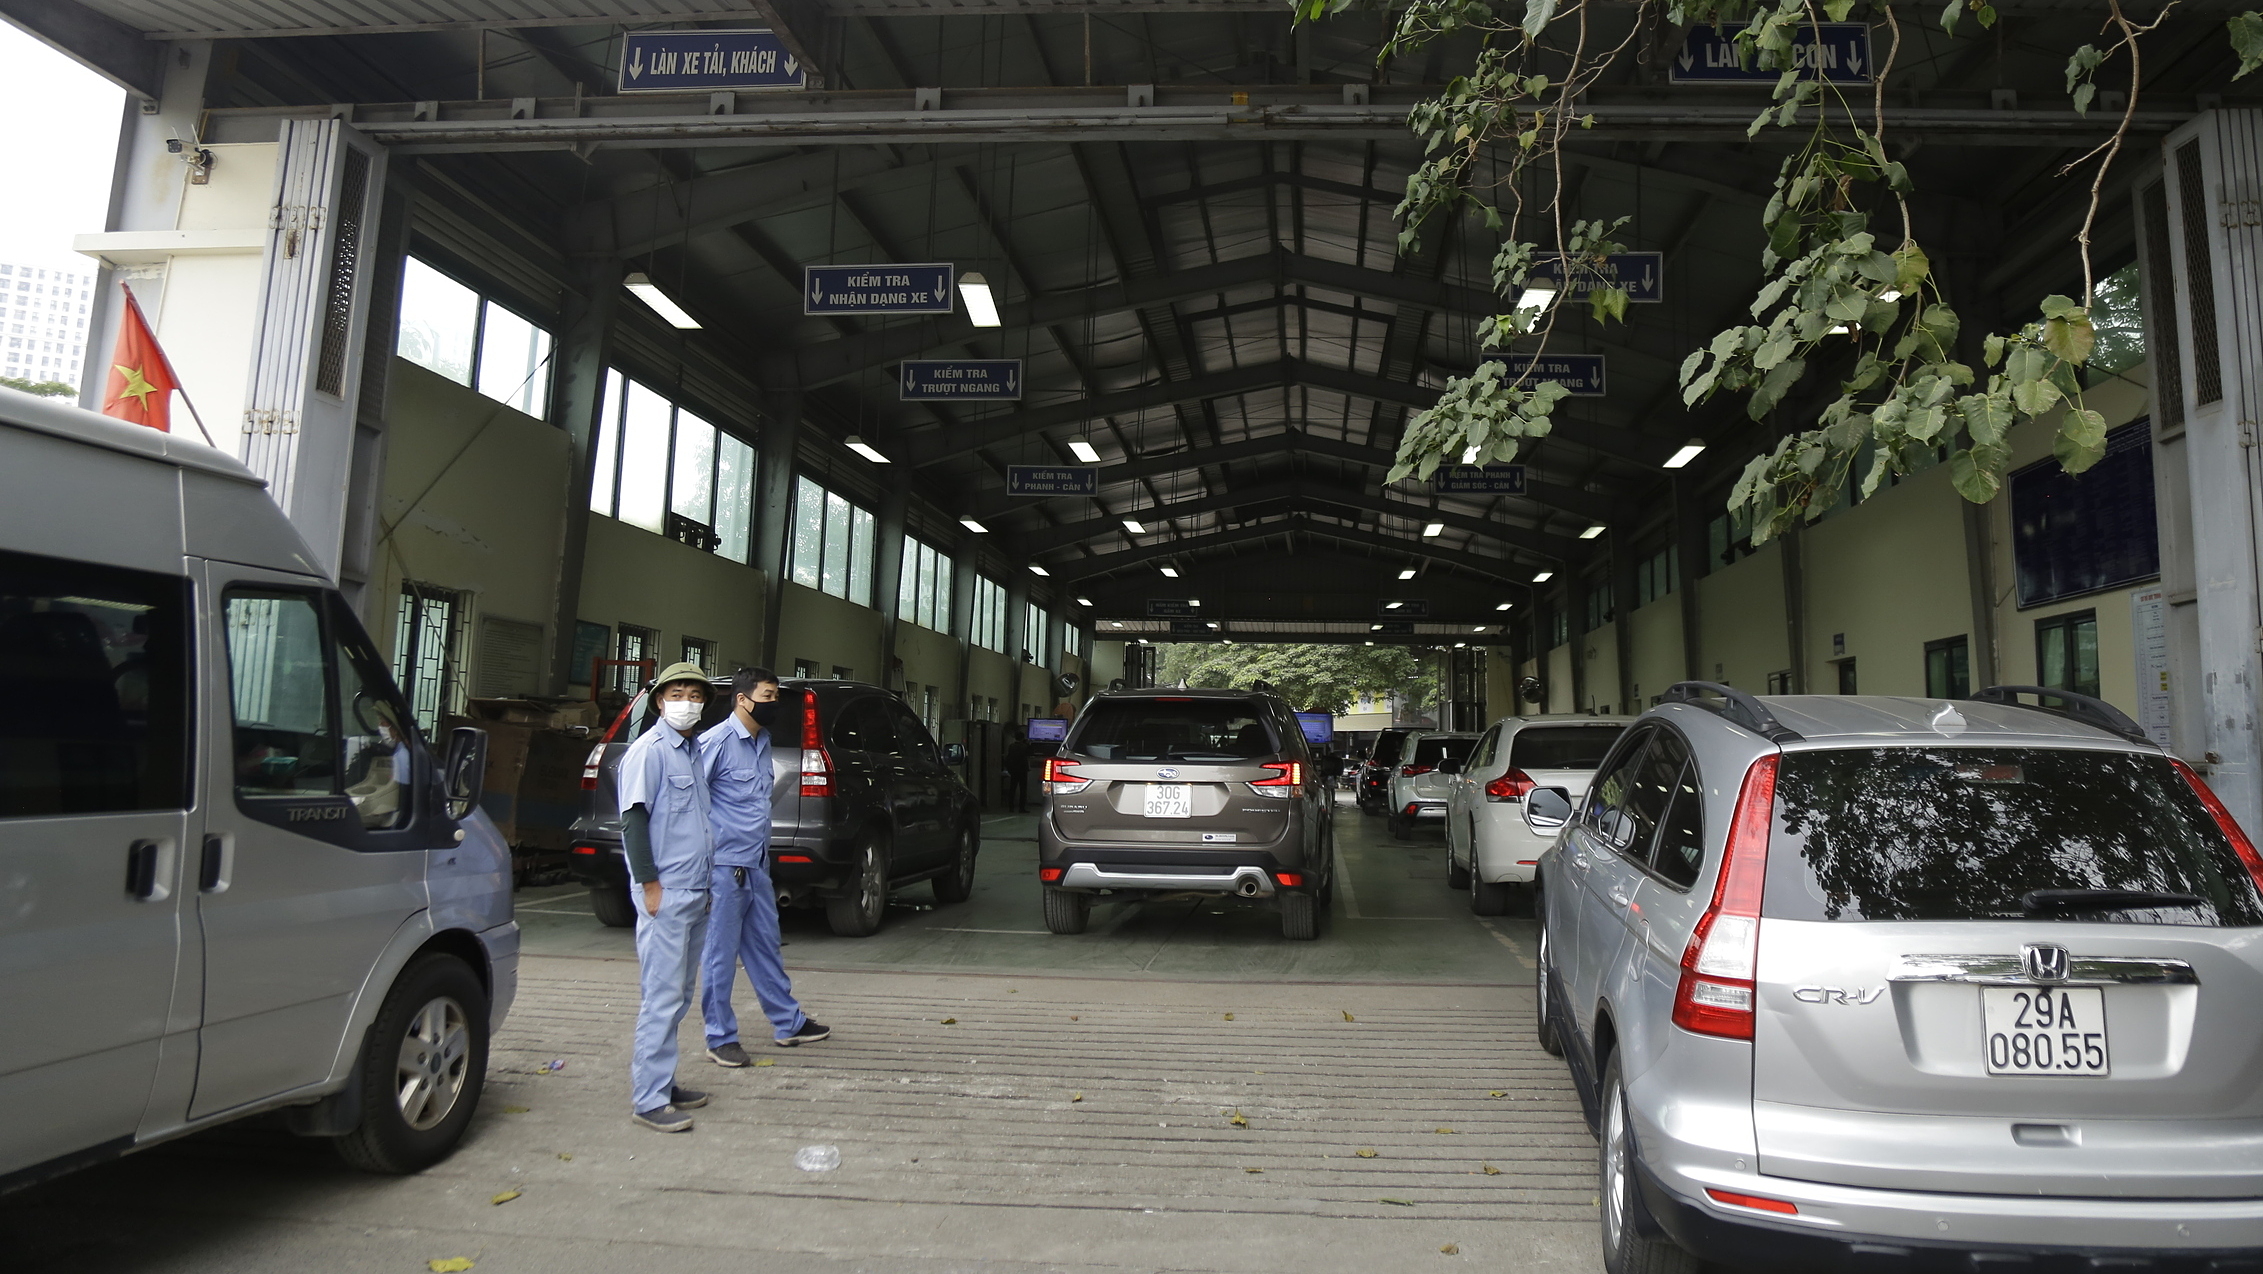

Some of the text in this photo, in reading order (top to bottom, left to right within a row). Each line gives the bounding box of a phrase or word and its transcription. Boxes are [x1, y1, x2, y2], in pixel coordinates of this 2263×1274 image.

[651, 43, 776, 77] LÀN XE TẢI, KHÁCH
[1792, 44, 1837, 69] CON
[847, 271, 910, 287] KIỂM TRA
[1619, 281, 1637, 293] XE
[829, 291, 928, 307] NHẬN DẠNG XE
[934, 365, 988, 379] KIỂM TRA
[1548, 364, 1570, 373] TRA
[922, 383, 1000, 396] TRƯỢT NGANG
[1542, 378, 1583, 388] NANG
[1056, 472, 1072, 480] TRA
[1485, 471, 1511, 479] PHANH
[1024, 483, 1054, 491] PHANH
[1156, 785, 1180, 800] 30G
[286, 806, 348, 822] TRANSIT
[1146, 800, 1189, 815] 367.24
[1792, 985, 1887, 1006] CR-V
[2013, 991, 2077, 1030] 29A
[1989, 1033, 2104, 1071] 080.55
